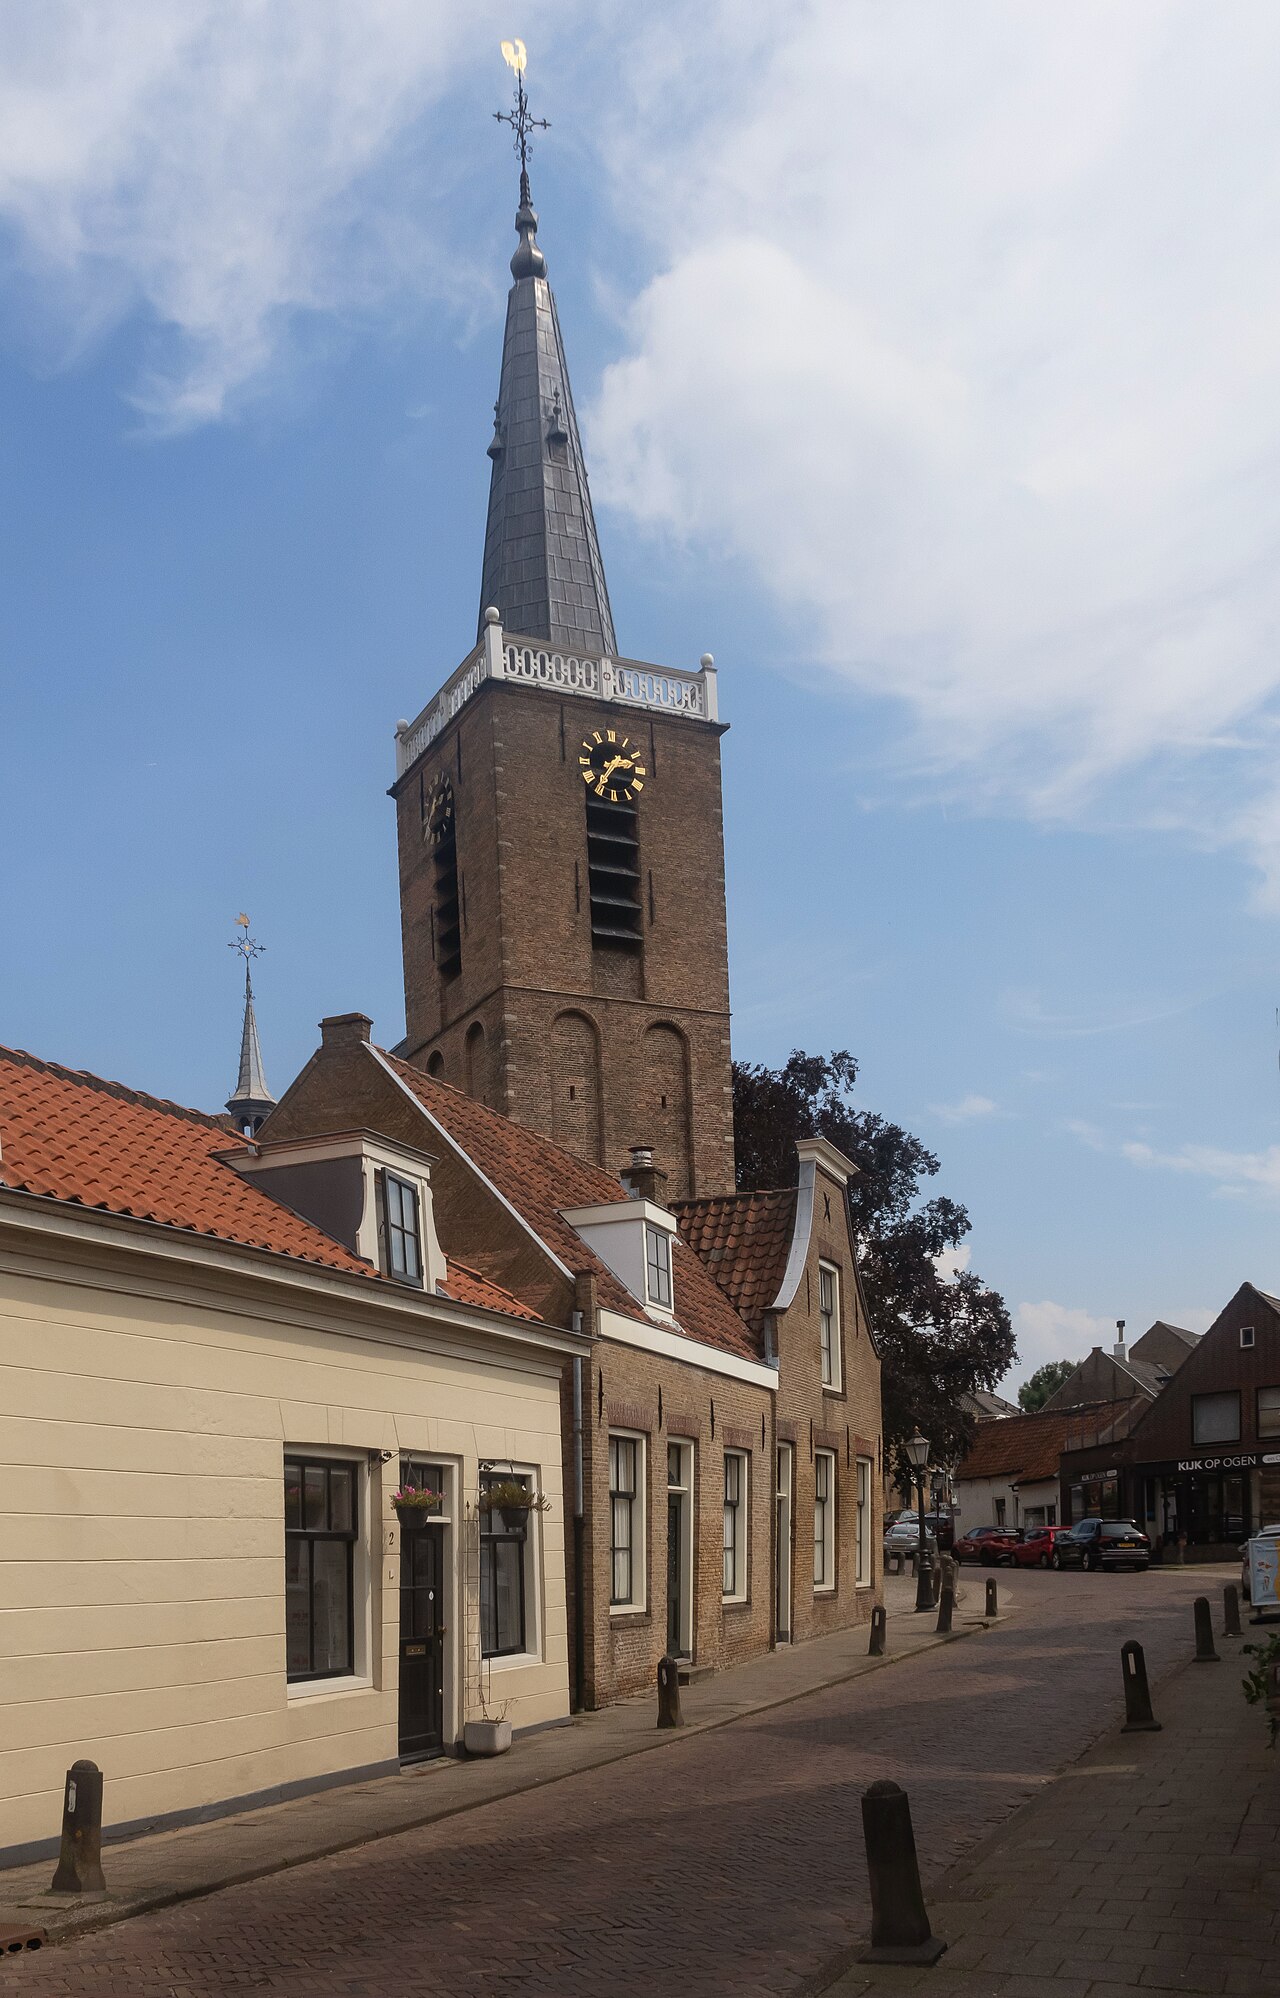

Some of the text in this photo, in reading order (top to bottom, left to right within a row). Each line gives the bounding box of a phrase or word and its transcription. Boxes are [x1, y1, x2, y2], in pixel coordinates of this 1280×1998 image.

[1178, 1460, 1203, 1471] KIJK
[1204, 1458, 1221, 1469] OP
[1222, 1455, 1256, 1467] OGEN
[389, 1532, 394, 1545] 2
